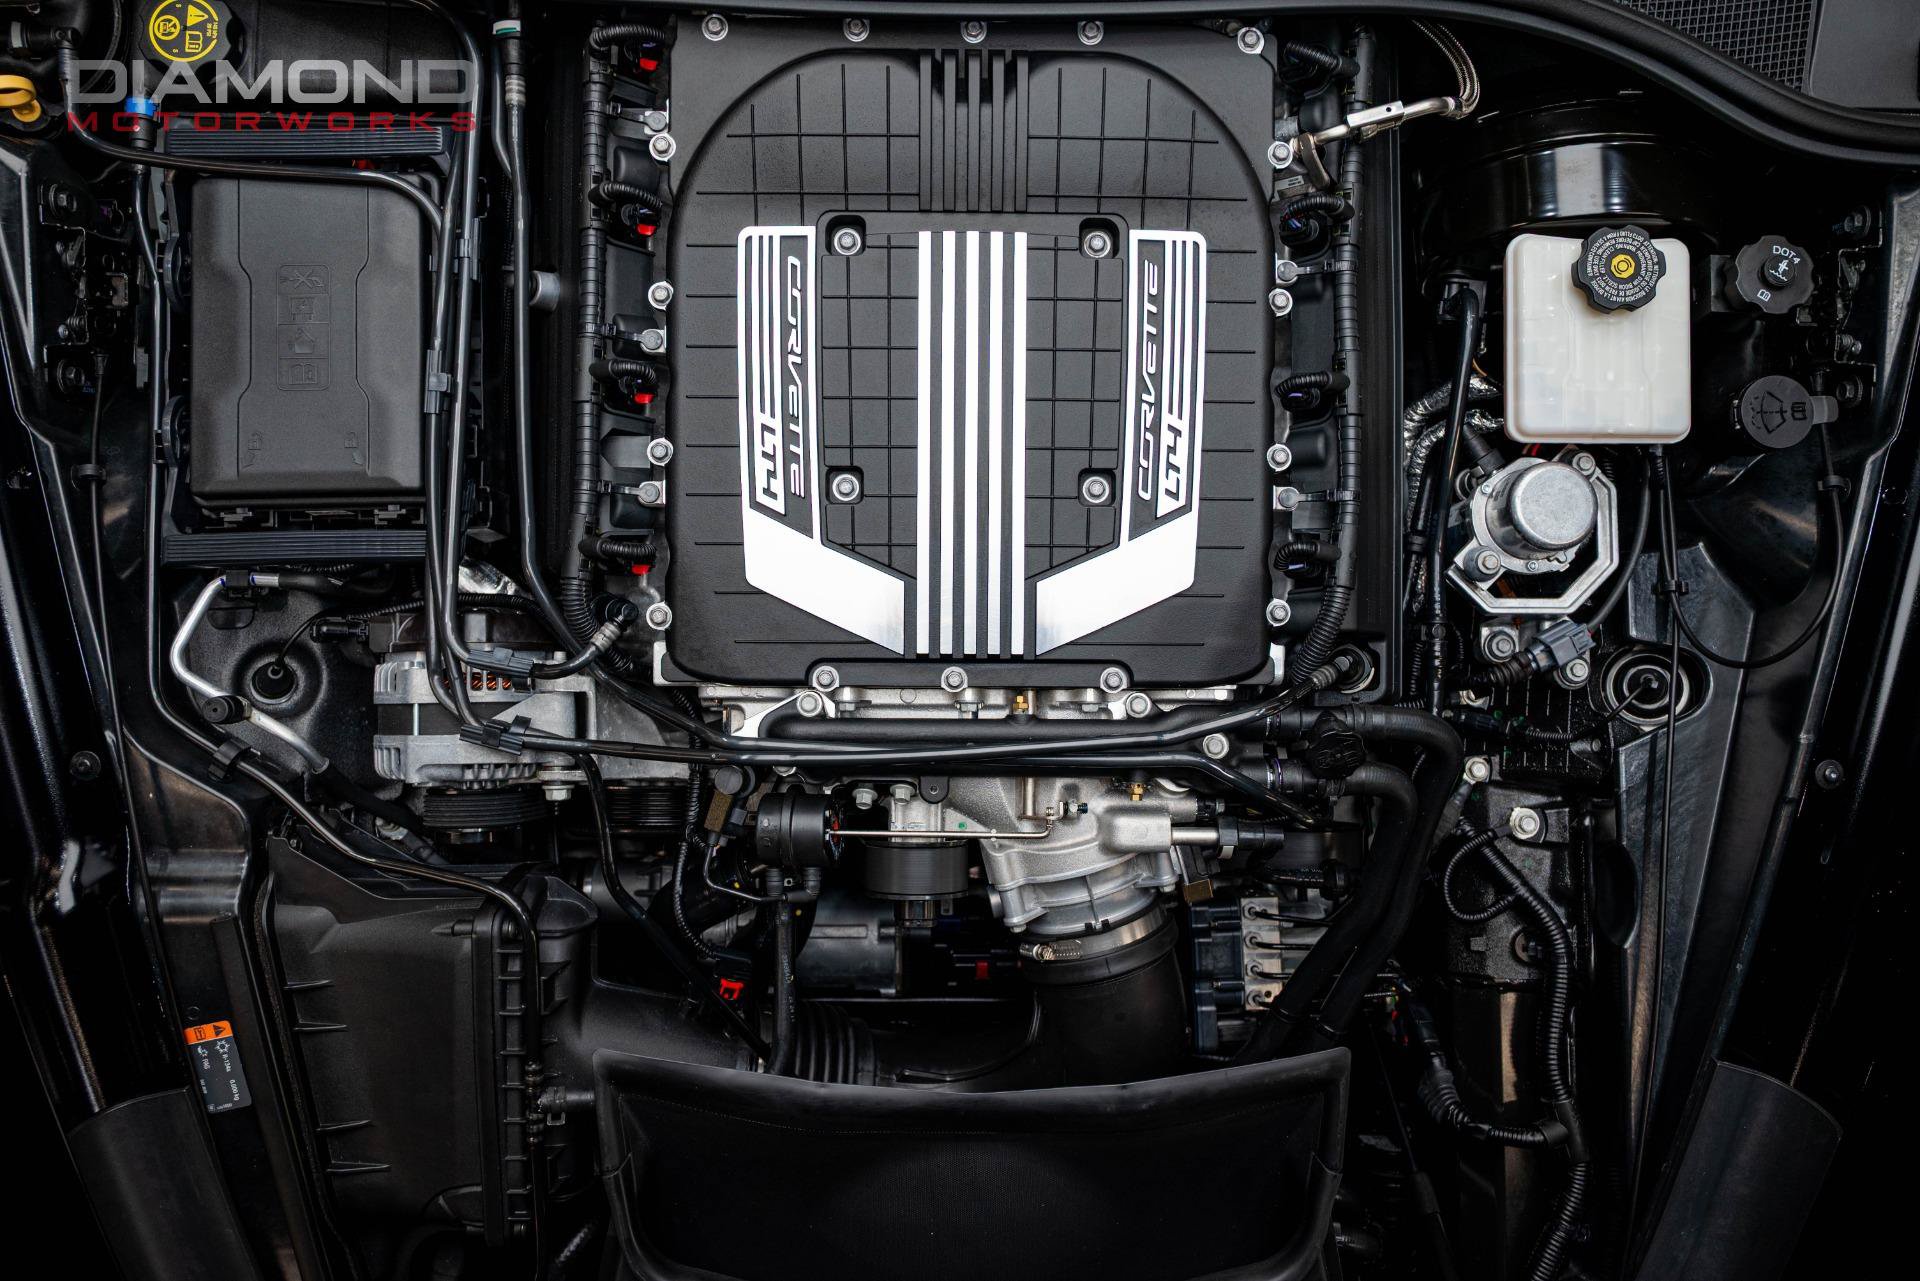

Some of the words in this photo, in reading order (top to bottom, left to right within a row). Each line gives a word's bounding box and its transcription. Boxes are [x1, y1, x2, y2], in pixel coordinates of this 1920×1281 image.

[787, 255, 805, 499] CORVETTE
[1138, 260, 1158, 501] CORVETTE
[760, 422, 778, 501] LT4
[1164, 423, 1182, 502] LT4
